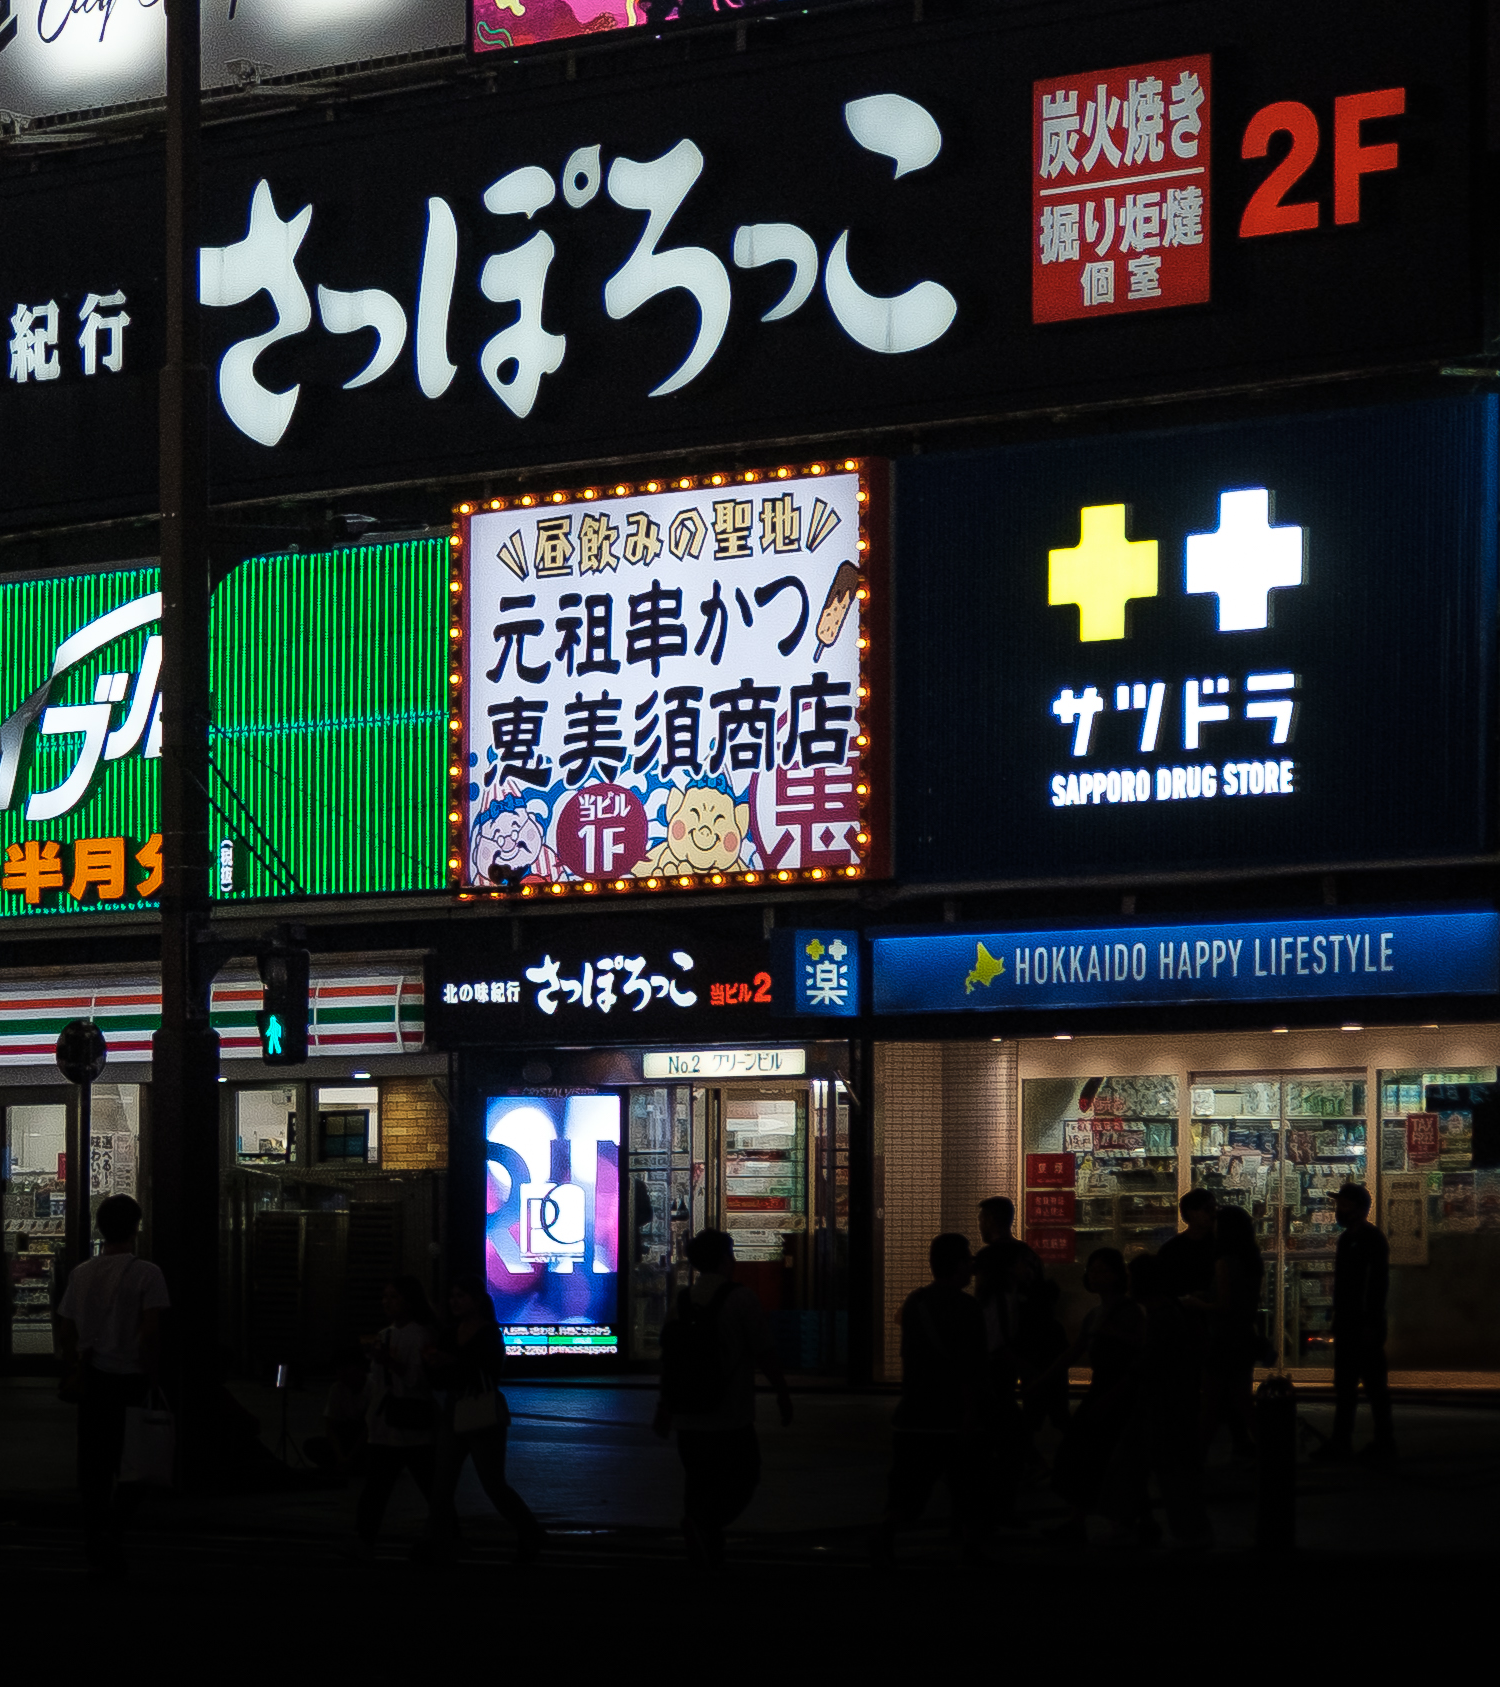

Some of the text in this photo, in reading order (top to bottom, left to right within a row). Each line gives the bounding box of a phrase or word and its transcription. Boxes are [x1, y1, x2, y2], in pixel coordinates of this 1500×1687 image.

[1040, 70, 1205, 179] 炭火焼き
[1239, 88, 1406, 238] 2F
[199, 92, 959, 449] さっぽろっこ
[1080, 255, 1161, 307] 個室
[533, 492, 803, 581] 昼飲みの聖地
[485, 576, 810, 685] 元祖串かつ
[483, 671, 853, 789] 恵美須商店
[1053, 672, 1297, 757] サツドラ
[578, 793, 630, 821] 当ビル
[1052, 760, 1295, 808] SAPPORO DRUG STORE
[579, 827, 625, 873] 1F
[525, 951, 698, 1015] さっぽろっこ
[805, 961, 849, 1006] 楽
[1014, 932, 1395, 986] HOKKAIDO HAPPY LIFESTYLE
[443, 980, 521, 1005] 北の味紀行
[711, 1052, 783, 1073] グリーンビル
